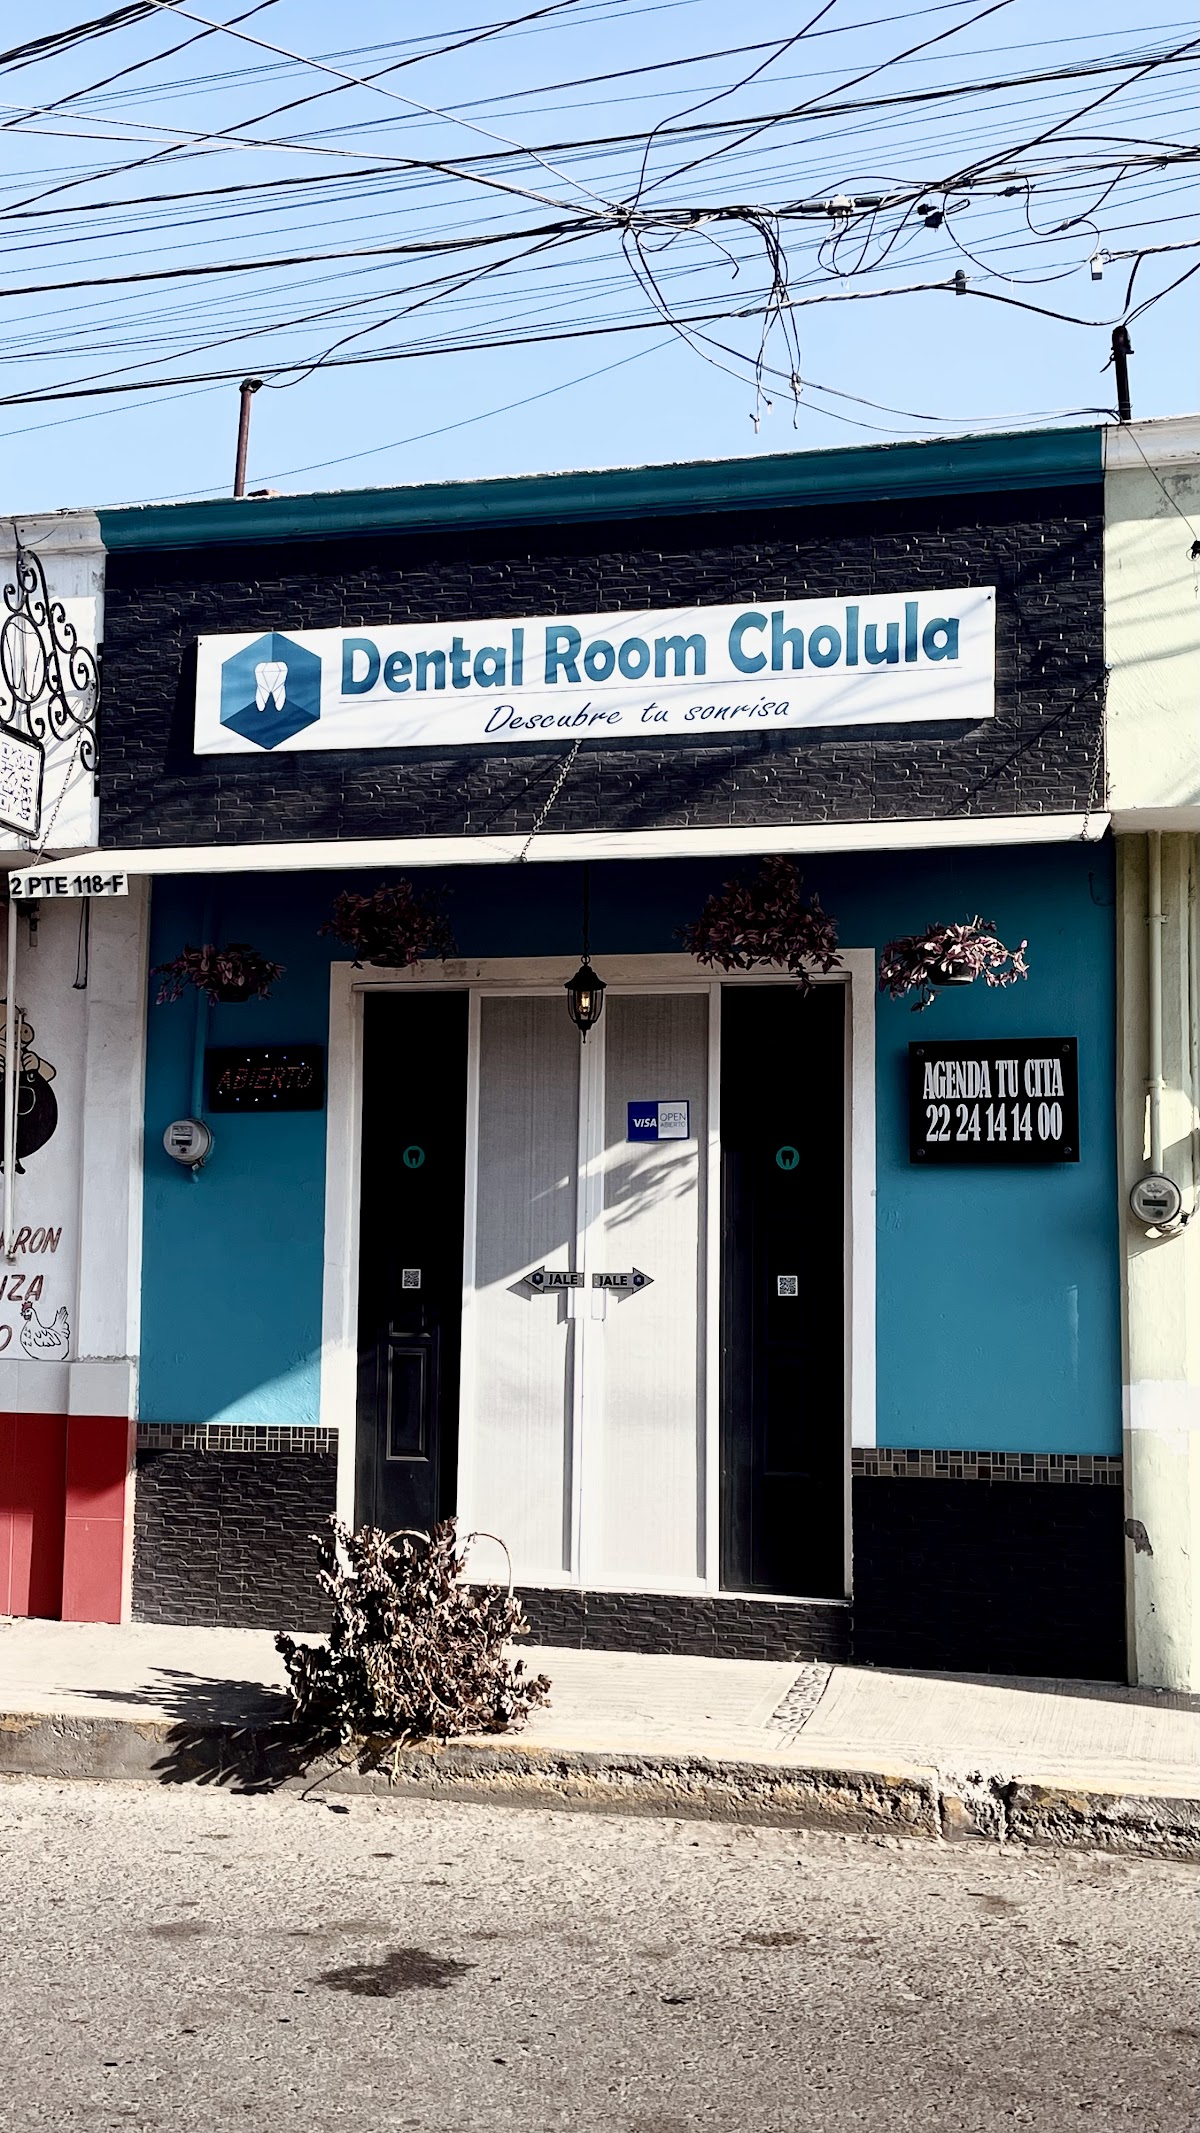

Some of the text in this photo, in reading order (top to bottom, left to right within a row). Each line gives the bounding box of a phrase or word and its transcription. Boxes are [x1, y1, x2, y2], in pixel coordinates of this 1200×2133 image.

[341, 601, 960, 695] Dental Room Cholula
[484, 697, 789, 733] Descubre tu sonrisa
[10, 874, 124, 895] 2 PTE 118-F
[216, 1065, 313, 1090] ABIERTO
[922, 1058, 1064, 1099] AGENDA TU CITA
[633, 1118, 657, 1128] VISA
[660, 1112, 686, 1122] OPEN
[926, 1102, 1063, 1141] 22 24 14 14 00
[549, 1274, 578, 1285] JALE
[599, 1275, 627, 1286] JALE
